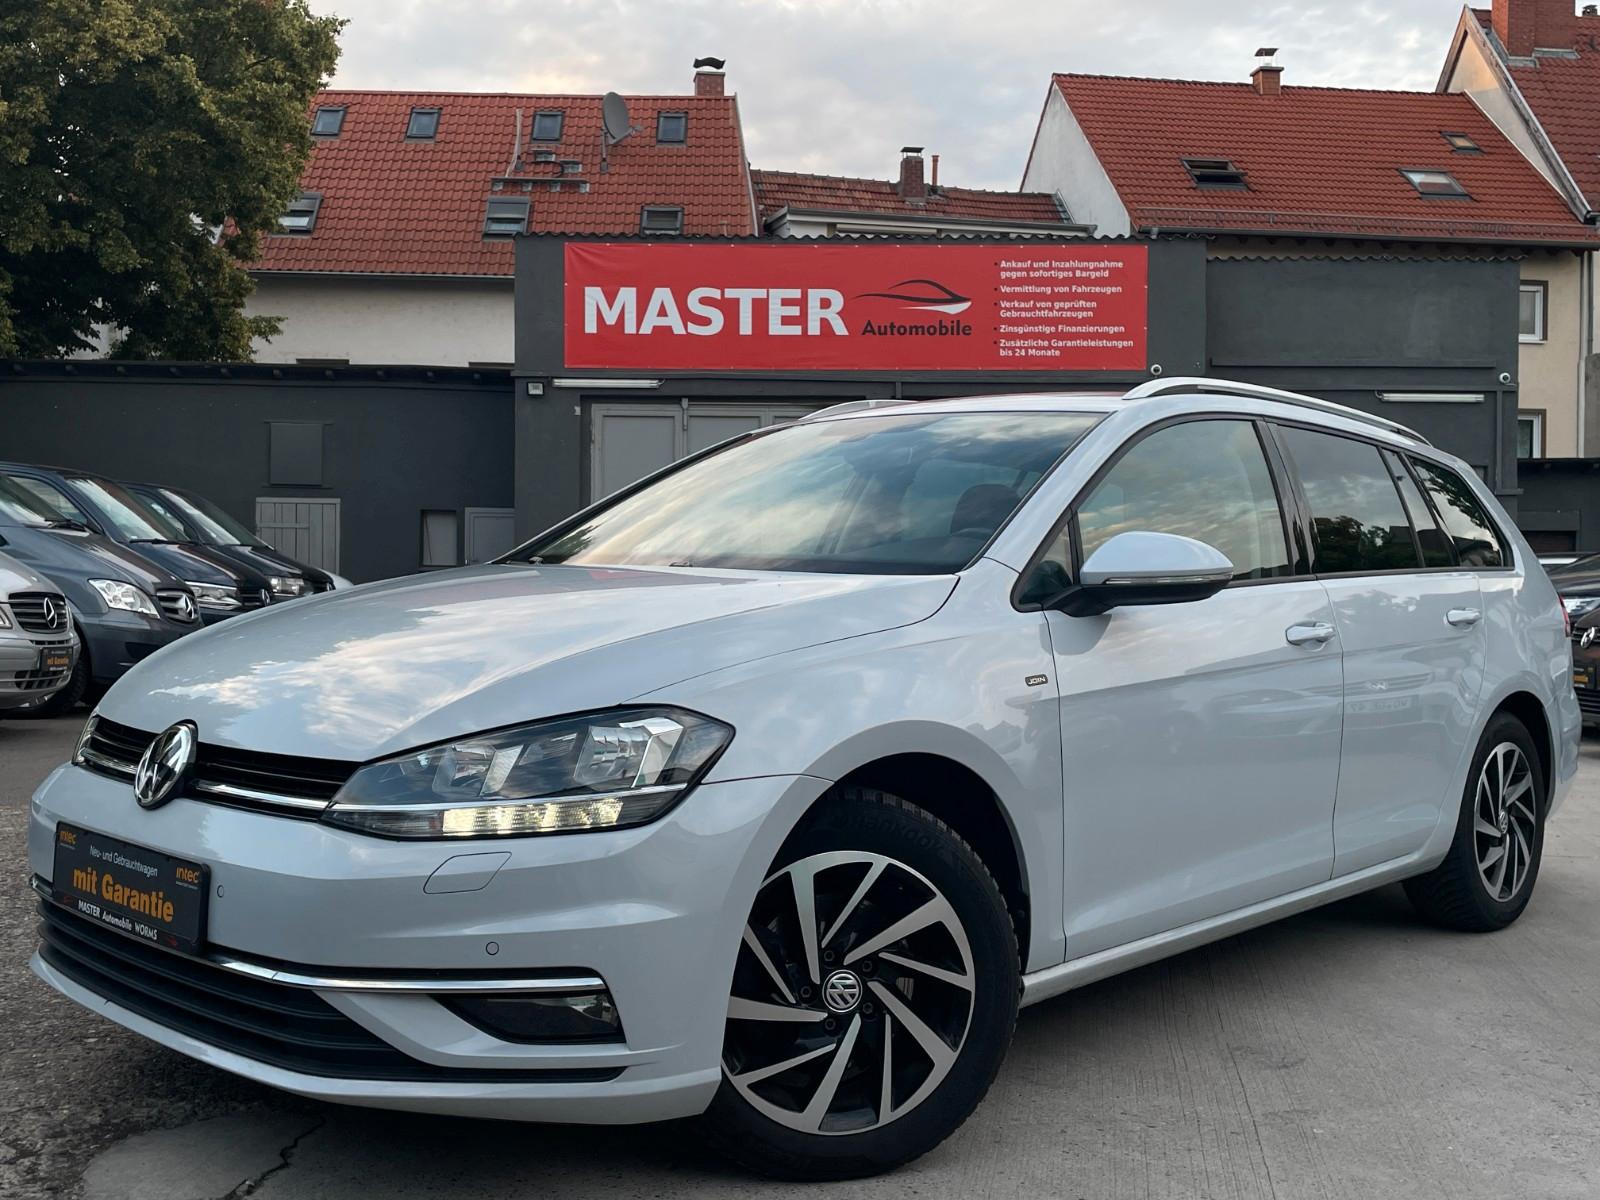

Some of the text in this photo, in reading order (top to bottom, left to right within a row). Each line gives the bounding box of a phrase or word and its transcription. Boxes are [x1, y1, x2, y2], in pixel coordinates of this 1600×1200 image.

[1000, 260, 1123, 270] Ankauf und Inzahlungnahme
[1029, 269, 1073, 279] sofortiges
[1075, 269, 1109, 279] Bargeld
[1000, 285, 1051, 294] Vermittlung
[1072, 285, 1122, 294] Fahrzeugen
[1000, 300, 1035, 308] Verkauf
[1054, 300, 1097, 309] geprüften
[583, 286, 849, 337] MASTER
[1000, 309, 1093, 318] Gebrauchtfahrzeugen
[861, 319, 972, 337] Automobile
[999, 324, 1125, 334] Zinsgünstige Finanzierungen
[999, 339, 1133, 348] Zusätzliche Garantieleistungen
[999, 348, 1061, 356] bis 24 Monate
[90, 844, 101, 857] Neu-
[102, 850, 113, 862] und
[113, 852, 158, 878] Gebrauchtwagen
[176, 867, 200, 883] intec
[73, 867, 174, 923] mit Garantie
[78, 899, 158, 940] MASTER Automobile WORMS
